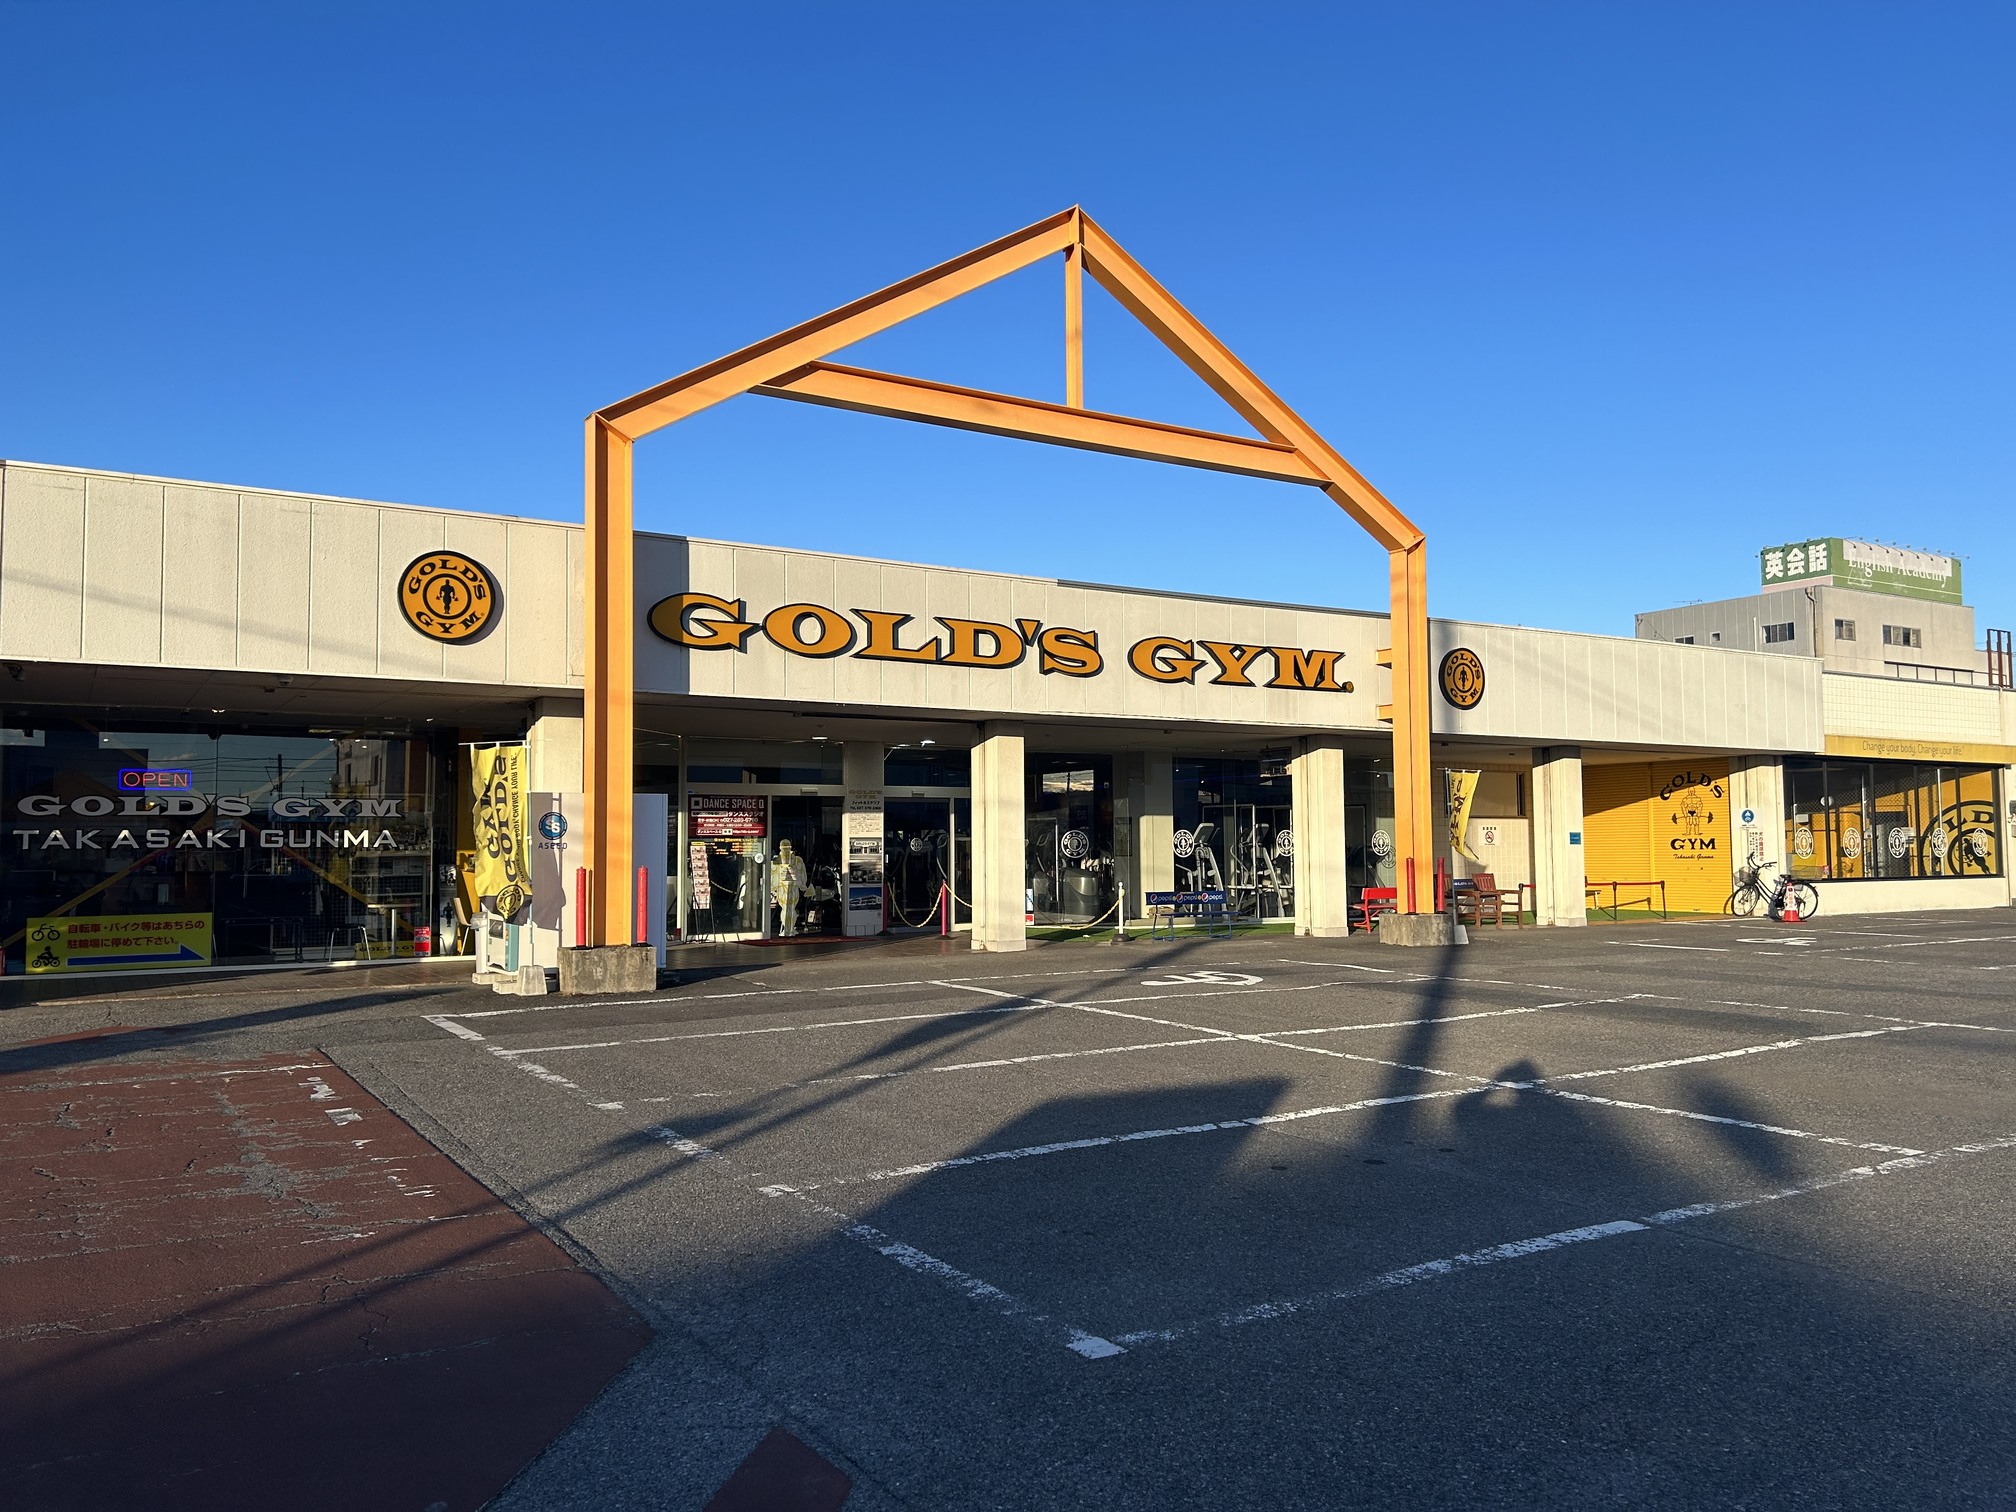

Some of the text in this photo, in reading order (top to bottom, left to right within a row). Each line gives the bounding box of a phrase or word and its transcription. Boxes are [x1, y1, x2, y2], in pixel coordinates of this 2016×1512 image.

[1764, 542, 1828, 579] 英会話
[1847, 548, 1948, 588] English Academy
[408, 558, 487, 601] GOLD'S
[415, 610, 482, 634] GYM
[647, 592, 1350, 693] GOLD'S GYM
[1446, 652, 1481, 680] GOLD'S
[1450, 687, 1479, 703] GYM
[1862, 740, 1886, 755] Change
[1886, 744, 1900, 756] your
[1917, 743, 1939, 758] Change
[1940, 746, 1952, 758] your
[123, 771, 188, 788] OPEN
[1660, 771, 1725, 801] GOLD'S
[17, 792, 406, 819] GOLD'S GYM
[703, 798, 765, 809] DANCE SPACE Q
[12, 828, 399, 850] TAKASAKI GUNMA
[1670, 837, 1716, 850] GYM
[1157, 893, 1223, 902] pepsi pepsi pepsi
[67, 919, 206, 935] 自転車・バイク等はあちらの
[66, 935, 179, 950] 駐輪場に停めて下さい。
